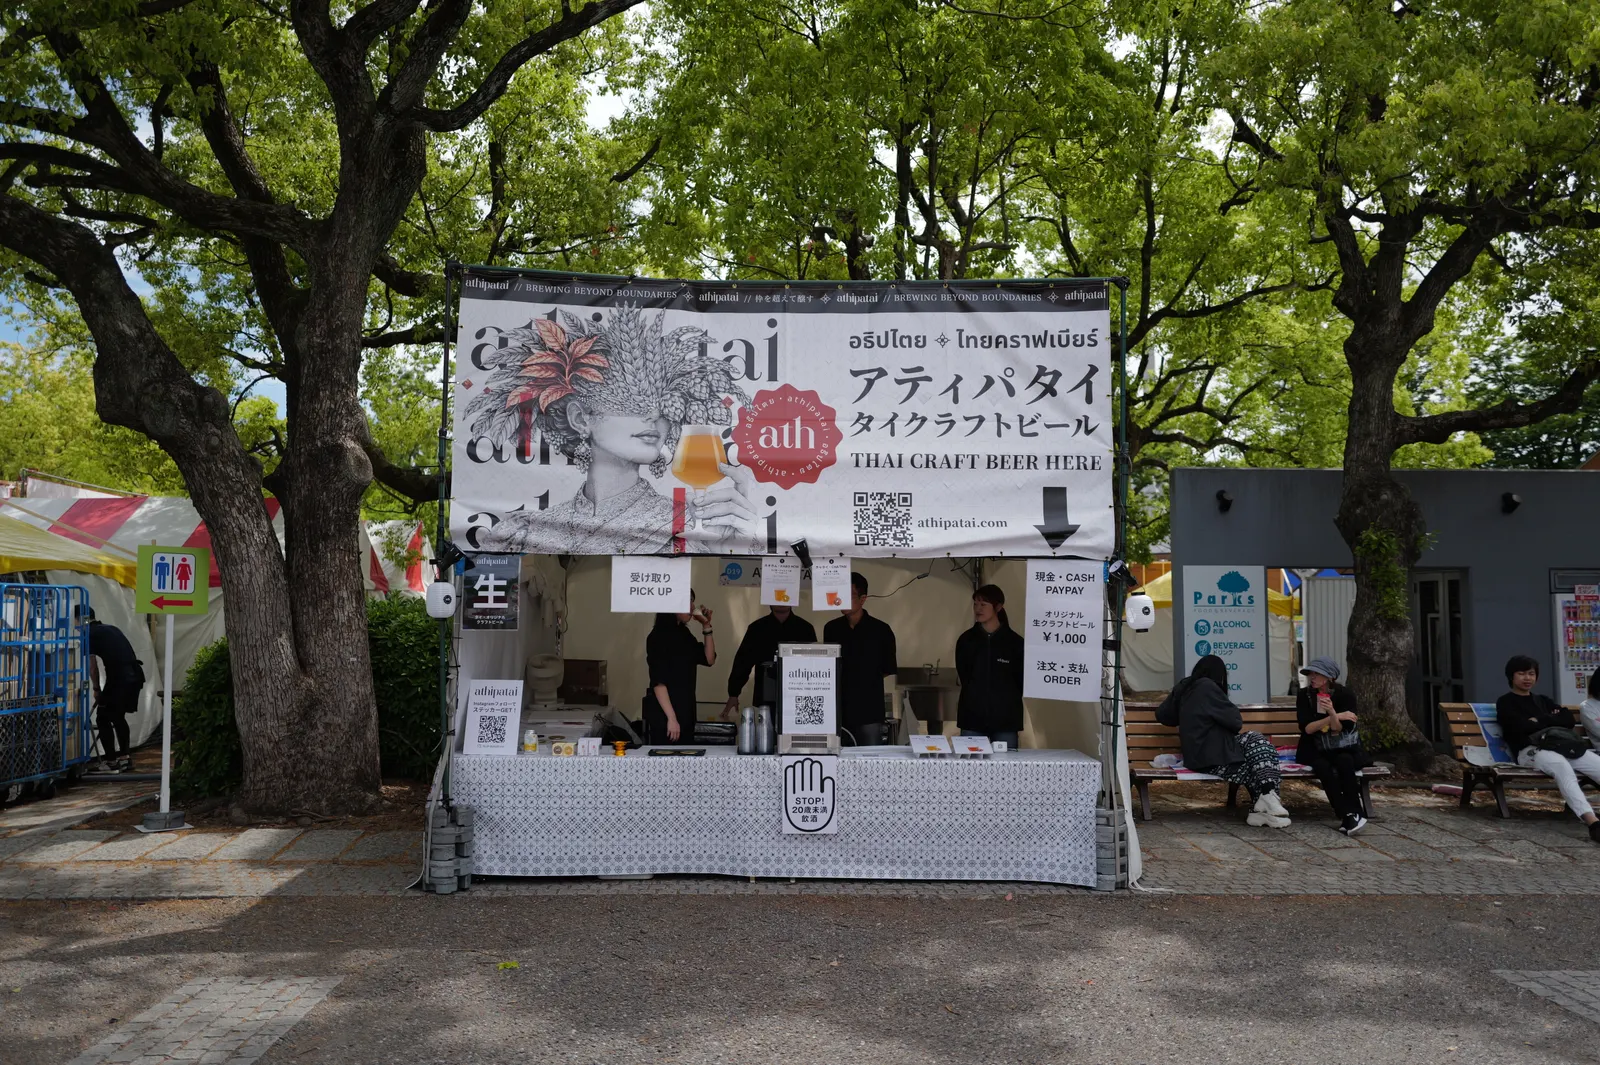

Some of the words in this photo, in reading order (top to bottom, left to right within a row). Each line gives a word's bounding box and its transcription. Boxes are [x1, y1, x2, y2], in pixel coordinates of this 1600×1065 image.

[465, 278, 509, 291] athipatai
[526, 284, 571, 293] BREWING
[574, 286, 613, 296] BEYOND
[616, 289, 677, 298] BOUNDARIES
[698, 291, 739, 304] athipatai
[836, 292, 878, 305] athipatai
[894, 293, 938, 302] BREWING
[940, 293, 979, 302] BEYOND
[982, 293, 1042, 301] BOUNDARIES
[1064, 289, 1106, 302] athipatai
[849, 329, 927, 349] อธิปไตย
[956, 328, 1099, 349] ไทยคราฟเบียร์
[849, 363, 1100, 406] アティパタイ
[787, 395, 830, 431] athipatai
[850, 411, 1100, 438] タイクラフトビール
[758, 415, 815, 449] ath
[850, 452, 904, 468] THAI
[910, 453, 980, 470] CRAFT
[986, 454, 1039, 470] BEER
[1045, 455, 1102, 471] HERE
[917, 517, 1008, 530] athipatai.com
[476, 557, 508, 567] athipatai
[630, 572, 671, 583] 受け取り
[473, 573, 509, 609] 生
[629, 586, 655, 596] PICK
[658, 586, 673, 596] UP
[1045, 586, 1085, 595] PAYPAY
[1193, 591, 1255, 606] Parks
[1045, 611, 1084, 619] オリジナル
[1032, 619, 1096, 629] 生クラフトビール
[1036, 660, 1089, 674] 注文・支払
[788, 668, 831, 681] athipatai
[1043, 675, 1081, 686] ORDER
[474, 686, 518, 698] athipatai
[795, 797, 825, 805] STOP!
[791, 806, 828, 814] 20歳未満
[801, 815, 818, 823] 飲酒
